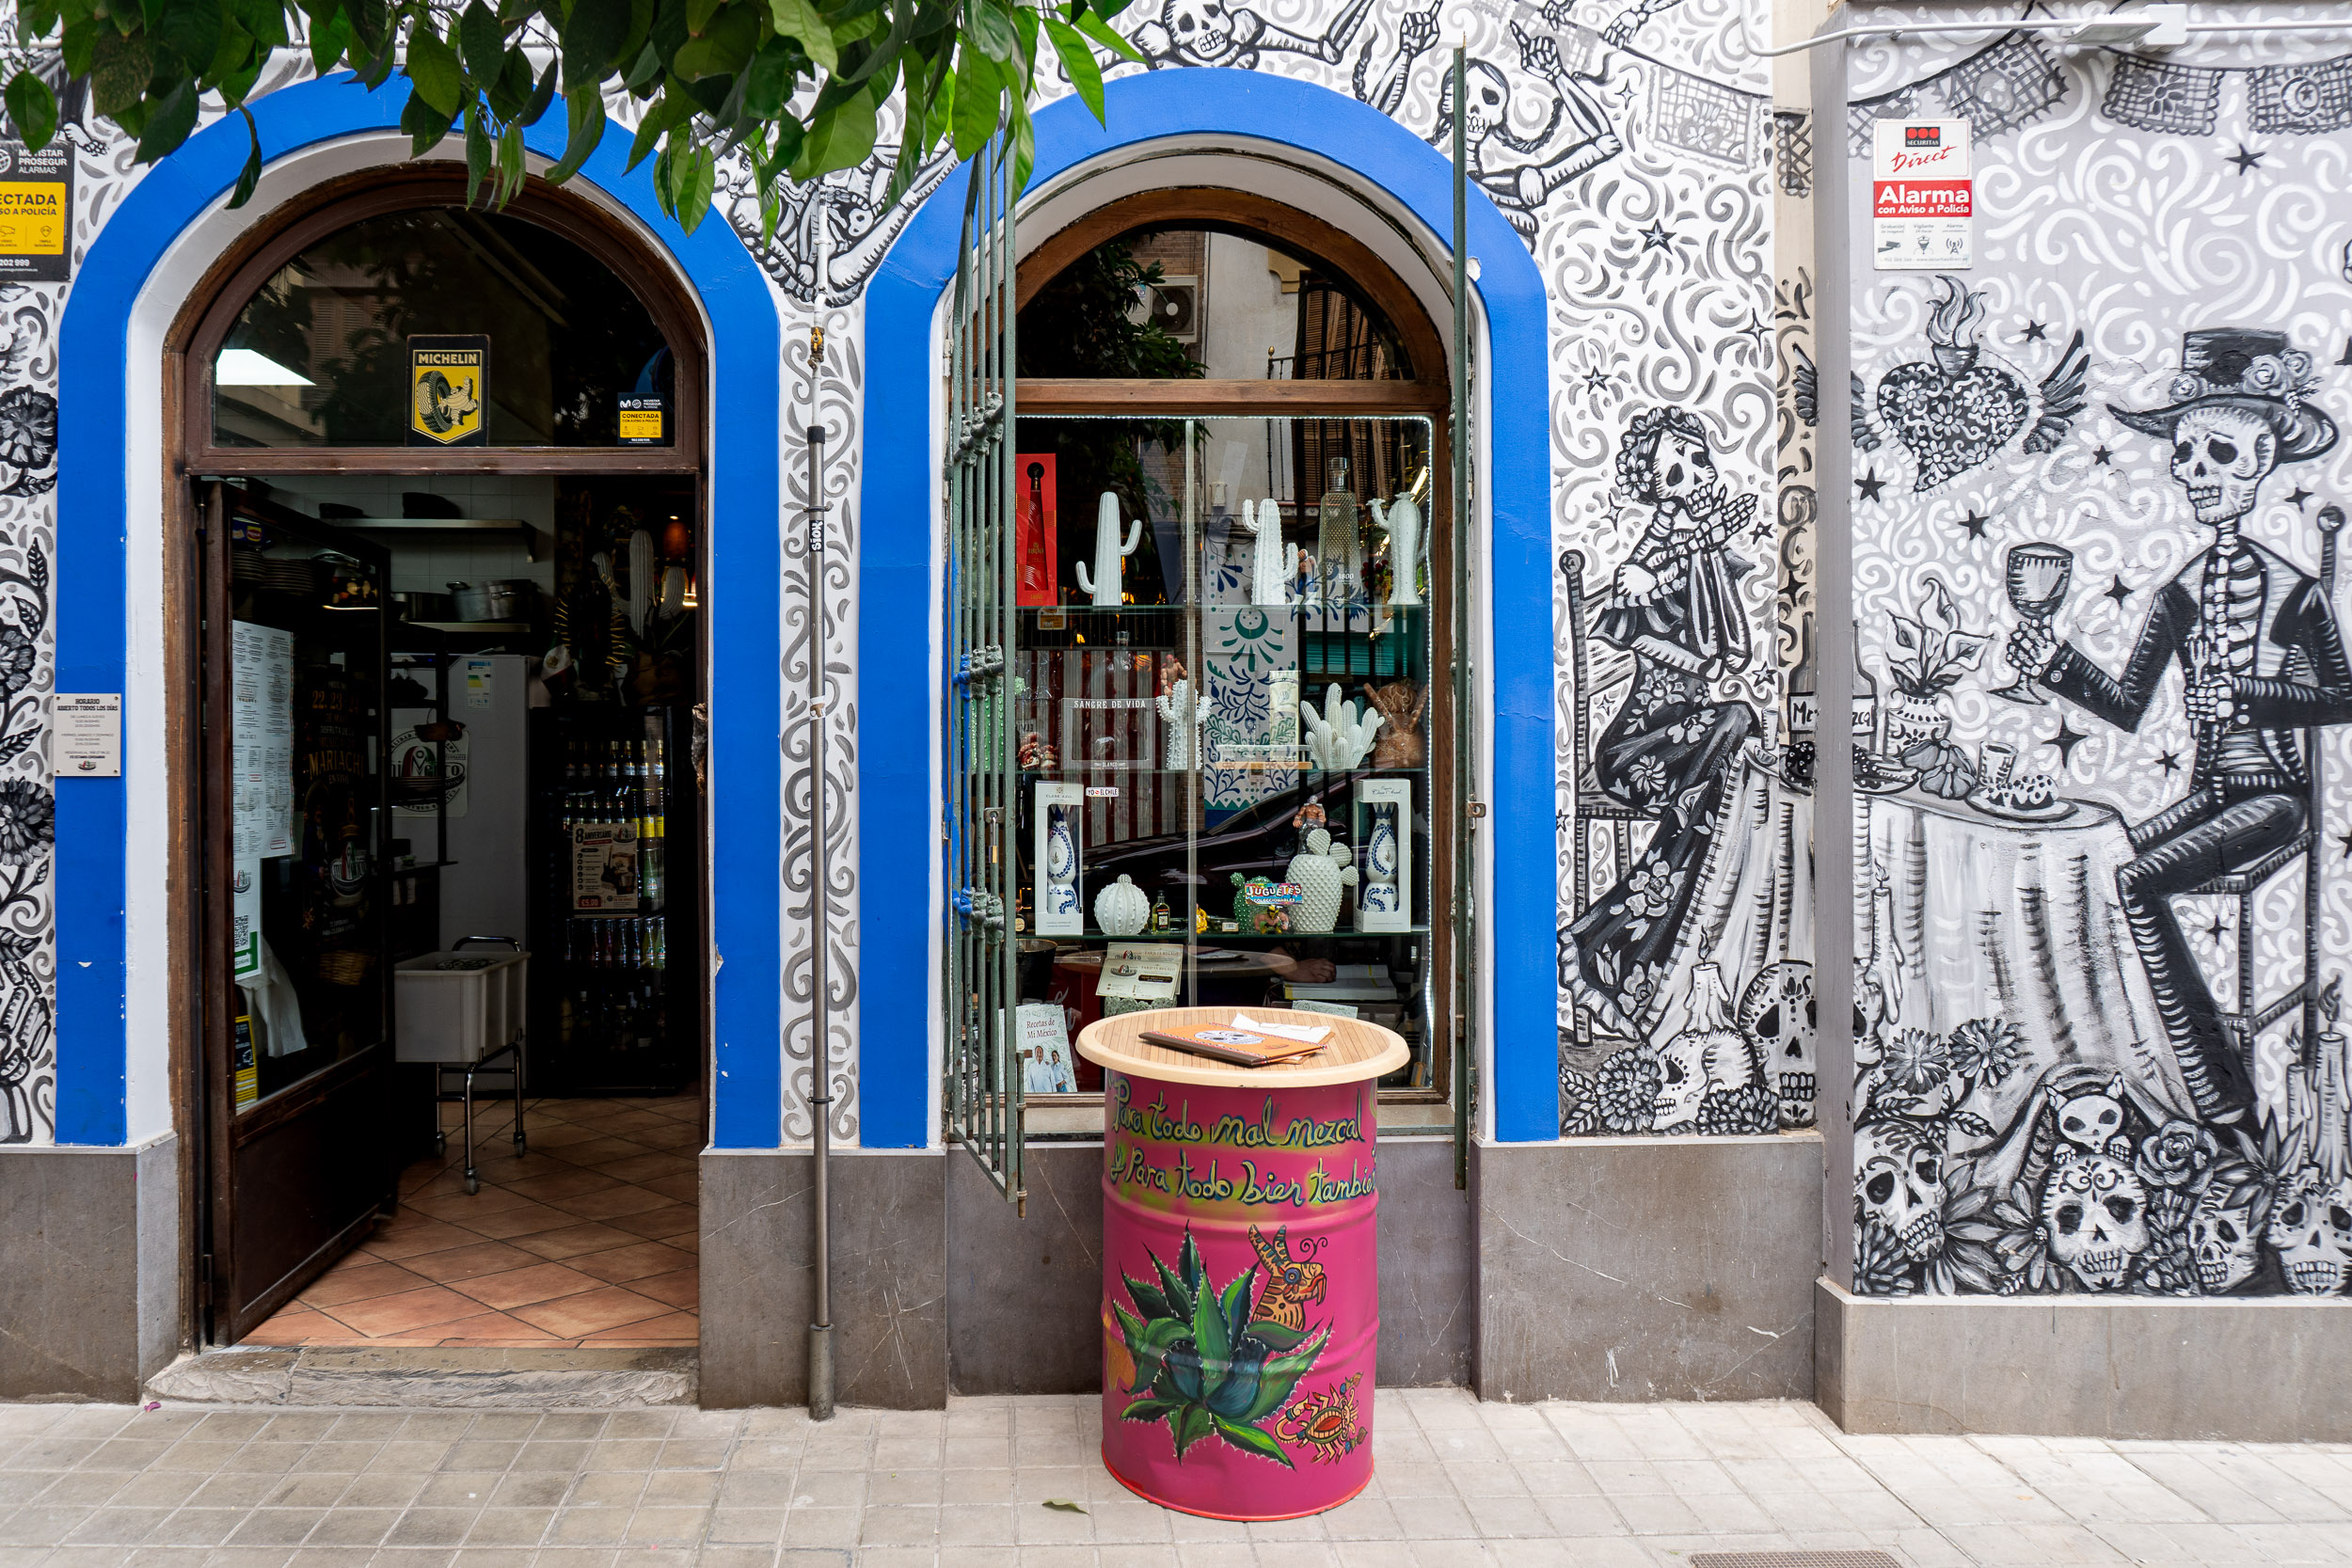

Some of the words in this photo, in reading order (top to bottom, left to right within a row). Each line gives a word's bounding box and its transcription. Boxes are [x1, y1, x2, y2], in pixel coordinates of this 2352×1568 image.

[19, 149, 64, 157] MOISTAR
[1890, 145, 1958, 173] Direct
[1878, 184, 1969, 204] Alarma
[21, 207, 56, 215] POLICÍA
[1878, 206, 1896, 214] con
[1898, 205, 1926, 214] Aviso
[1937, 204, 1970, 214] Policía
[14, 259, 30, 267] 999
[418, 354, 477, 365] MICHELIN
[1073, 700, 1107, 708] SANGRE
[1111, 700, 1121, 708] DE
[1126, 700, 1146, 708] VIDA
[309, 750, 366, 782] MARIACHI
[575, 828, 583, 844] 8
[1246, 884, 1301, 896] JUGUETES
[1026, 1020, 1047, 1029] Recetas
[1047, 1017, 1056, 1026] de
[1036, 1028, 1057, 1038] México
[1113, 1076, 1146, 1133] Para
[1148, 1090, 1202, 1141] todo
[1210, 1095, 1276, 1148] mal
[1280, 1087, 1366, 1148] mezcal
[1124, 1144, 1170, 1193] Para
[1174, 1148, 1233, 1200] todo
[1237, 1160, 1306, 1207] bien
